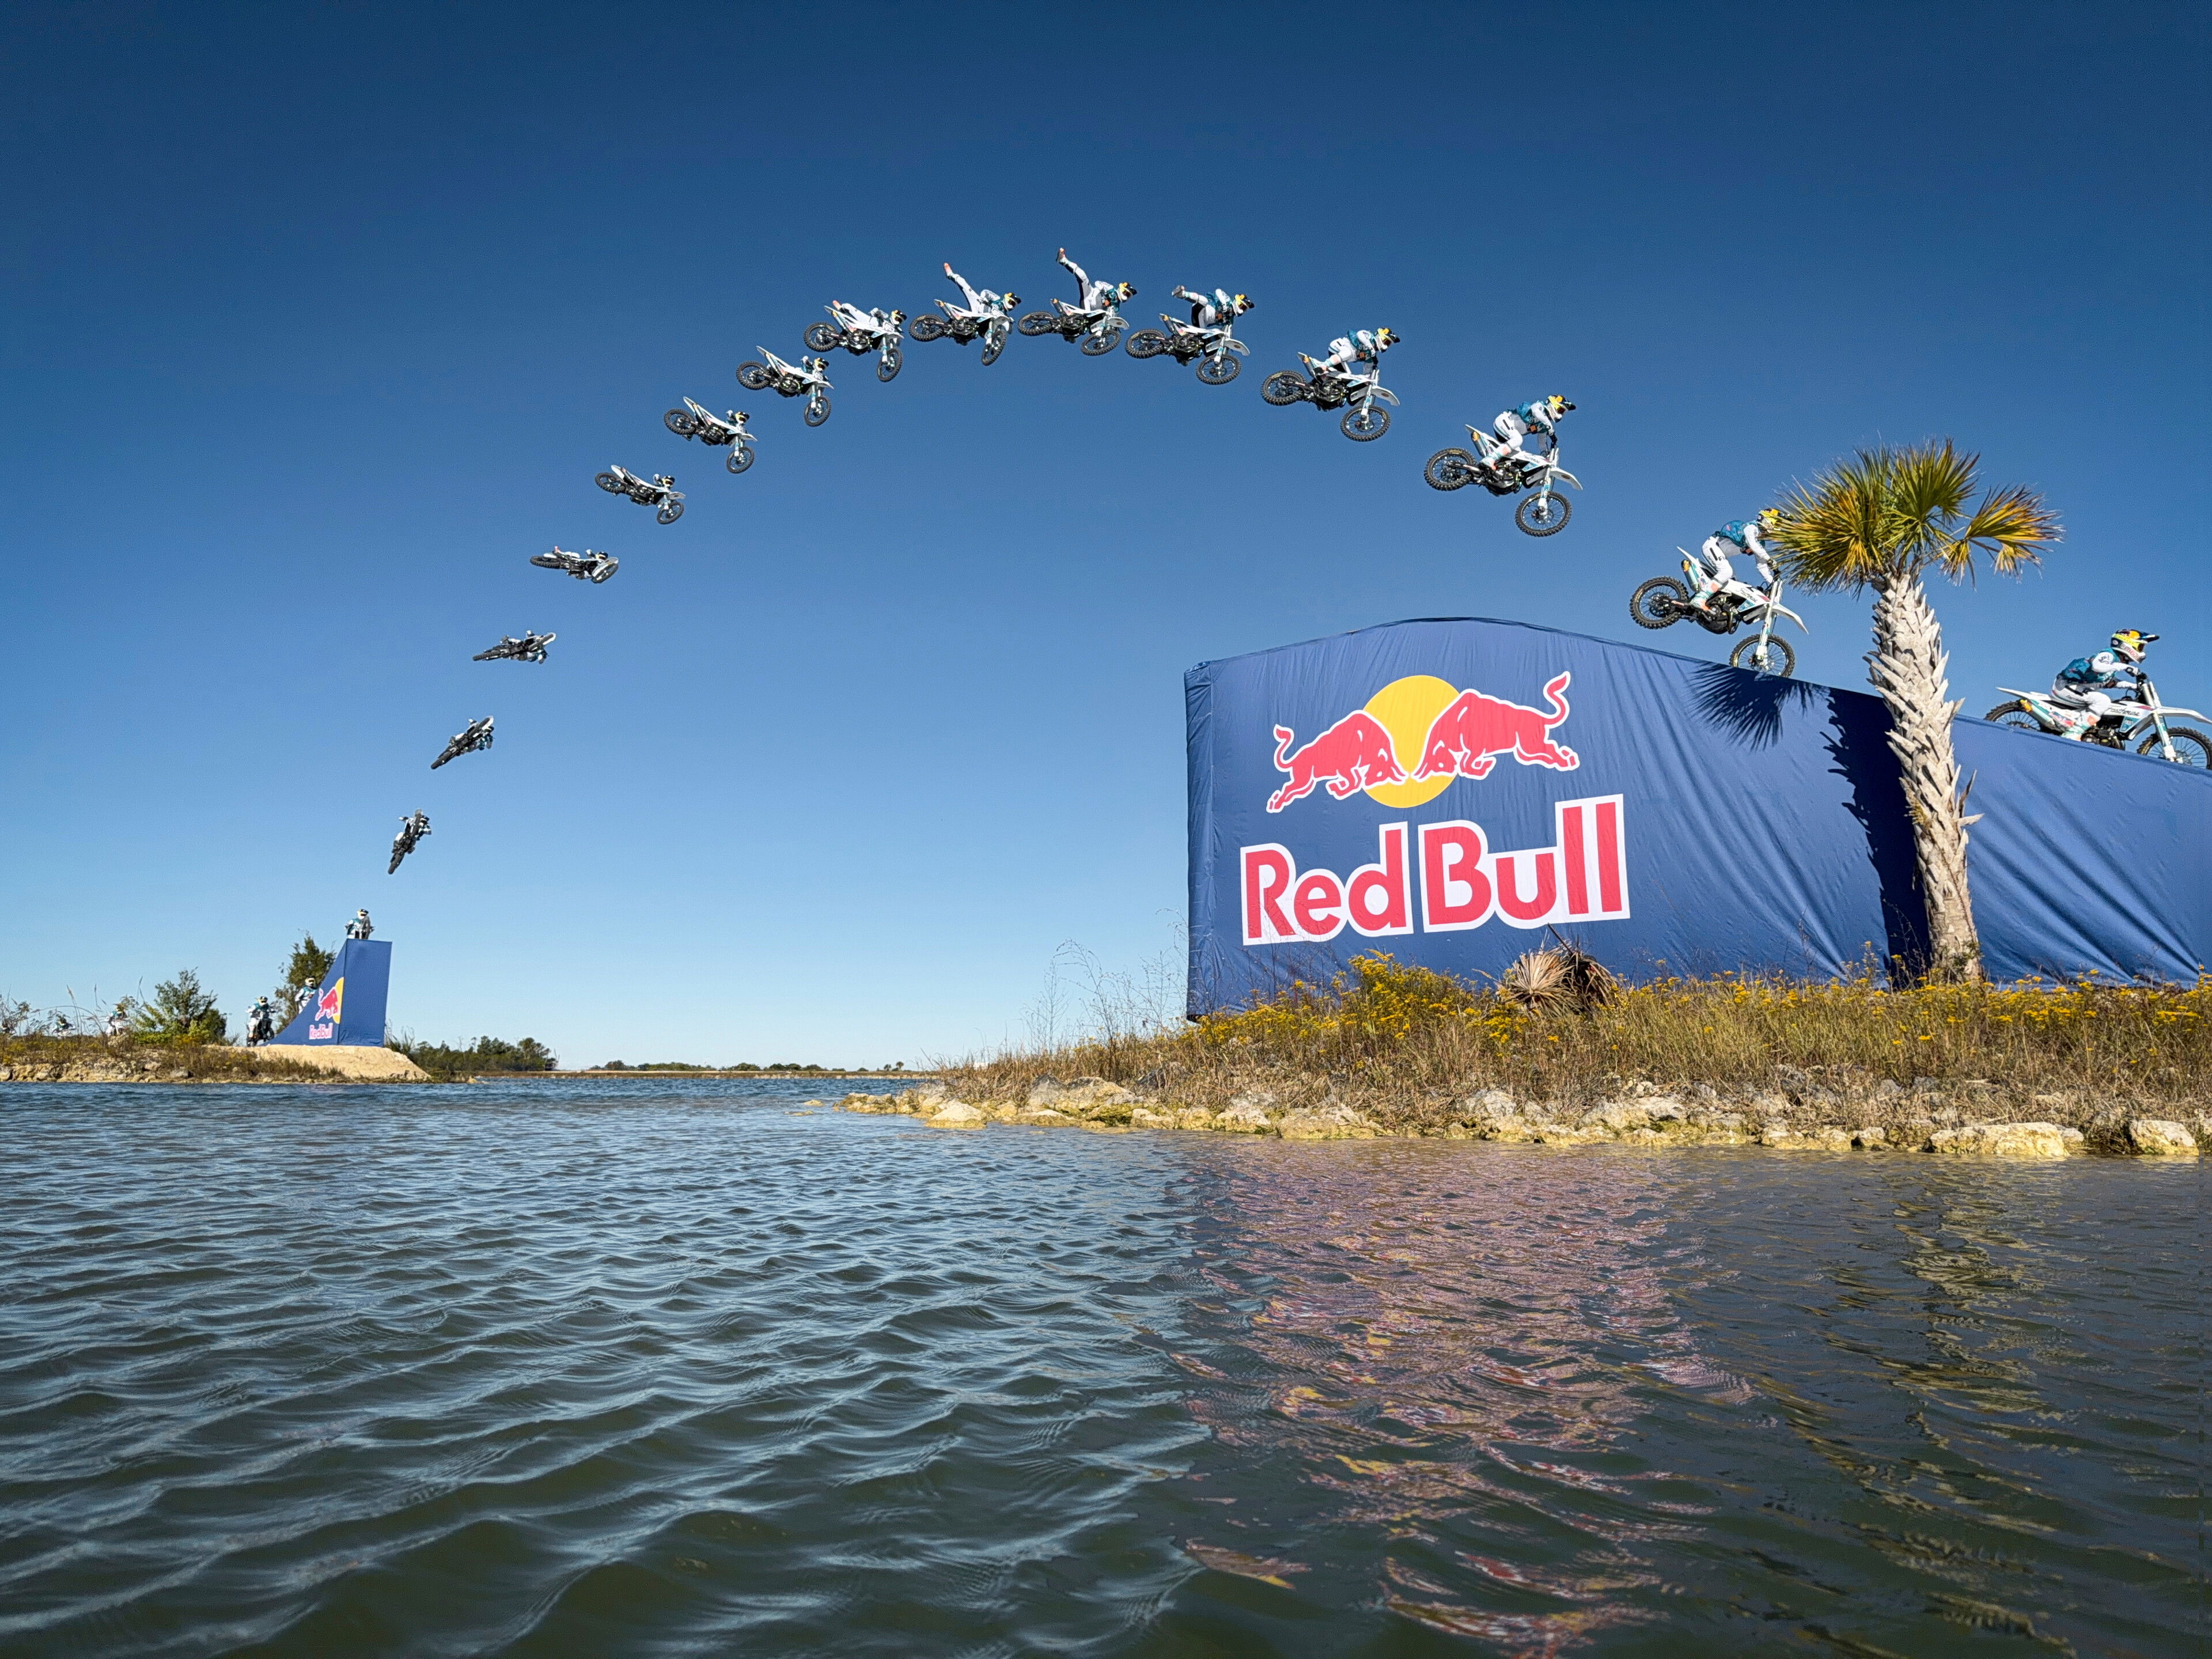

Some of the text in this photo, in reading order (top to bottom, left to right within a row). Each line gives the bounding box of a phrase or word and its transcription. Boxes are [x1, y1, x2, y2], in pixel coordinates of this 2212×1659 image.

[1240, 794, 1630, 945] Red Bull
[309, 1022, 333, 1040] Red Bull
